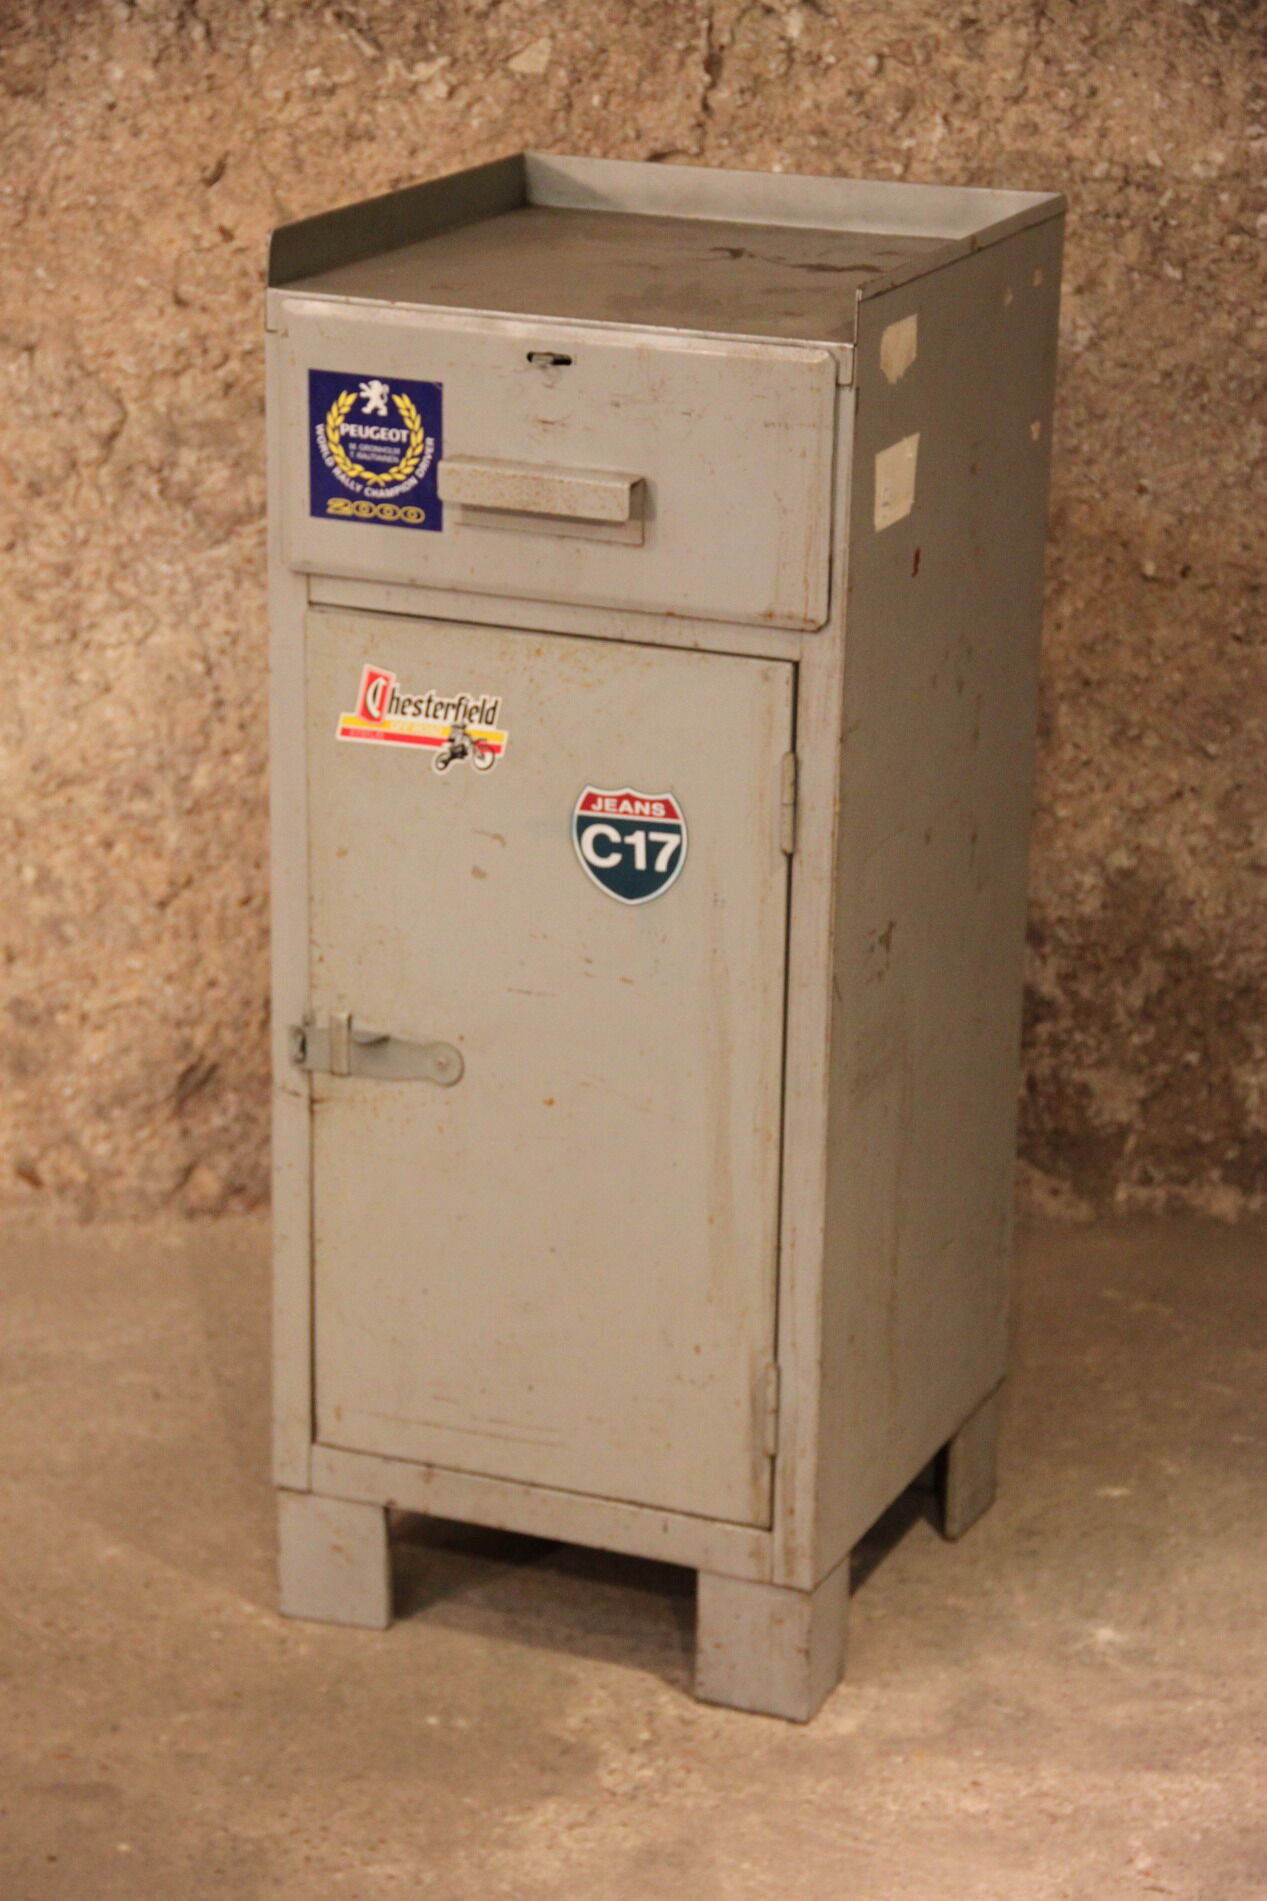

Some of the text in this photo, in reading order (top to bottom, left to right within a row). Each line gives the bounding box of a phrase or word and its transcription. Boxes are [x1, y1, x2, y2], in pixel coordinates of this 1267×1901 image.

[340, 423, 409, 443] PEUGEOT
[315, 423, 434, 498] WORLD RALLY CHAMPION DRIVER
[327, 497, 425, 523] 2000
[365, 677, 499, 725] Chesterfield
[591, 797, 666, 817] JEANS
[581, 823, 681, 873] C17
